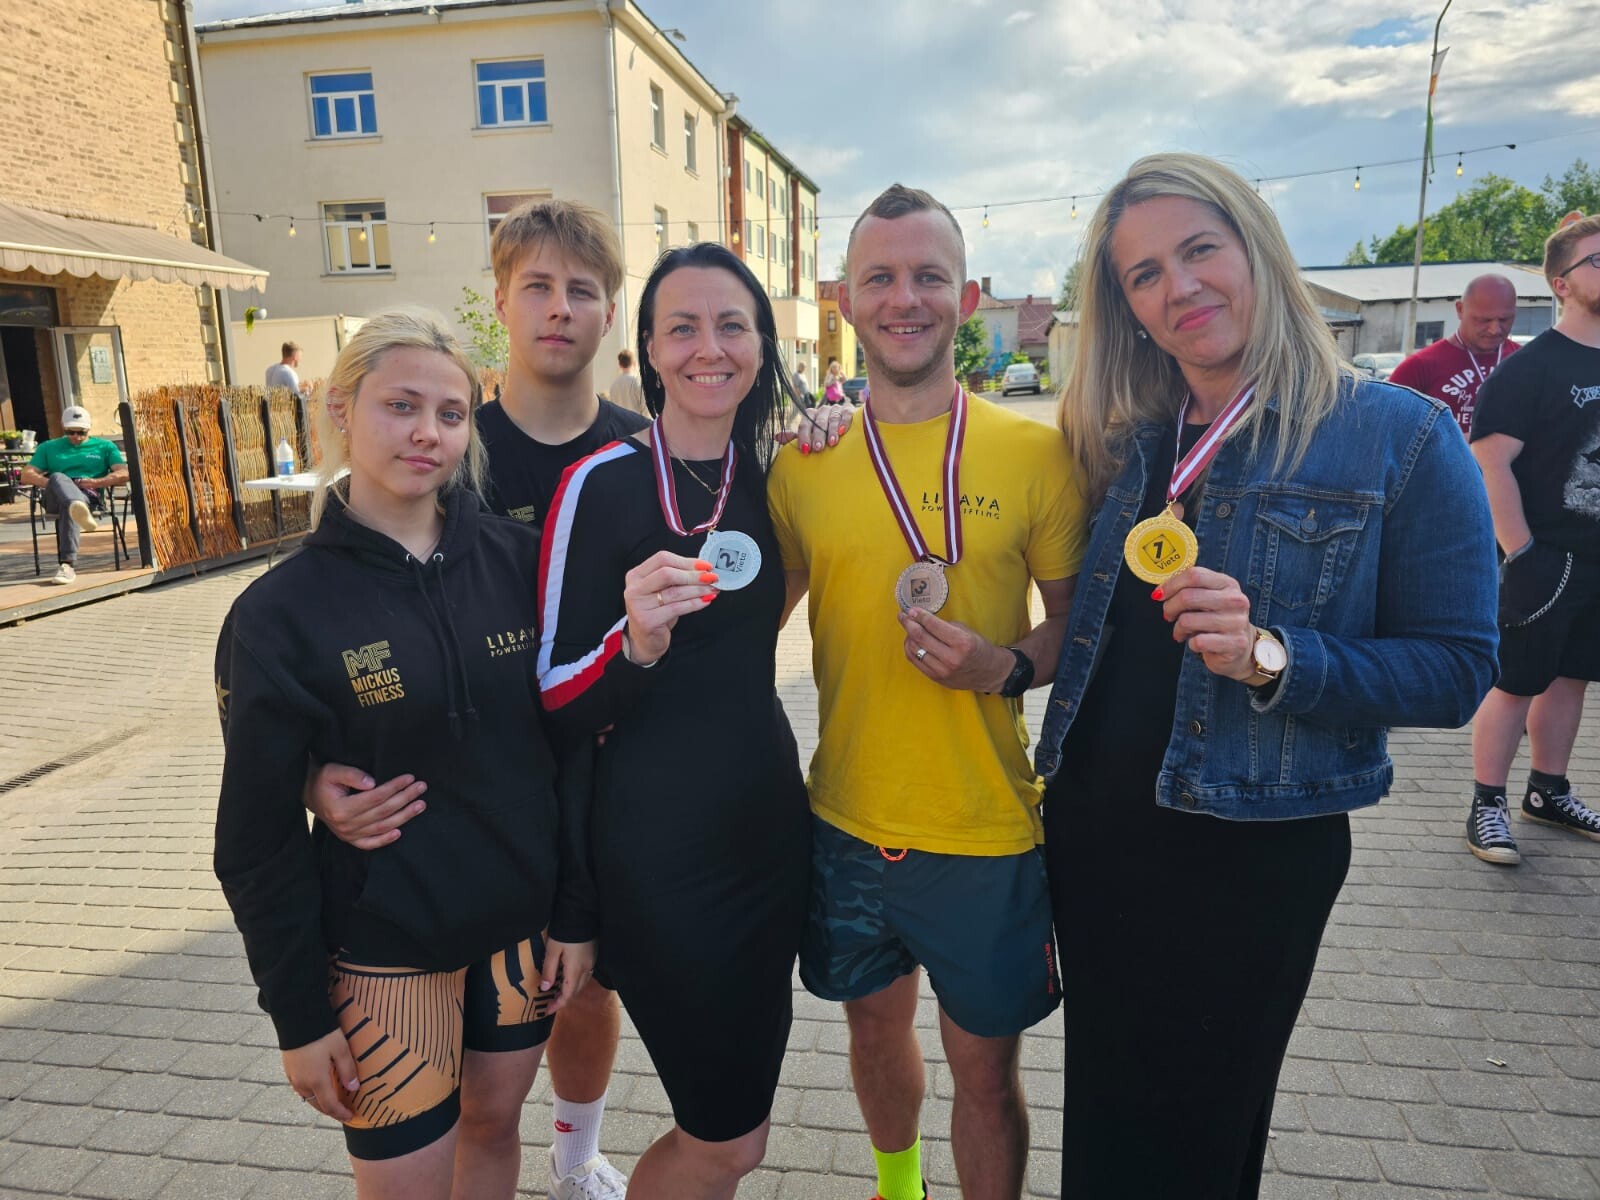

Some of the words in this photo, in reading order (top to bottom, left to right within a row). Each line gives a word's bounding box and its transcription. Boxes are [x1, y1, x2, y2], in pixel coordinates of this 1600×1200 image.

[1441, 366, 1495, 396] SUP
[922, 492, 1000, 511] LIAVA
[921, 505, 1000, 519] POWIFTING
[719, 552, 736, 568] 2
[1153, 541, 1164, 559] 1
[914, 580, 928, 595] 3
[486, 627, 535, 649] LIBAV
[341, 640, 391, 679] MF
[350, 667, 401, 693] MICKUS
[357, 683, 405, 708] FITNESS
